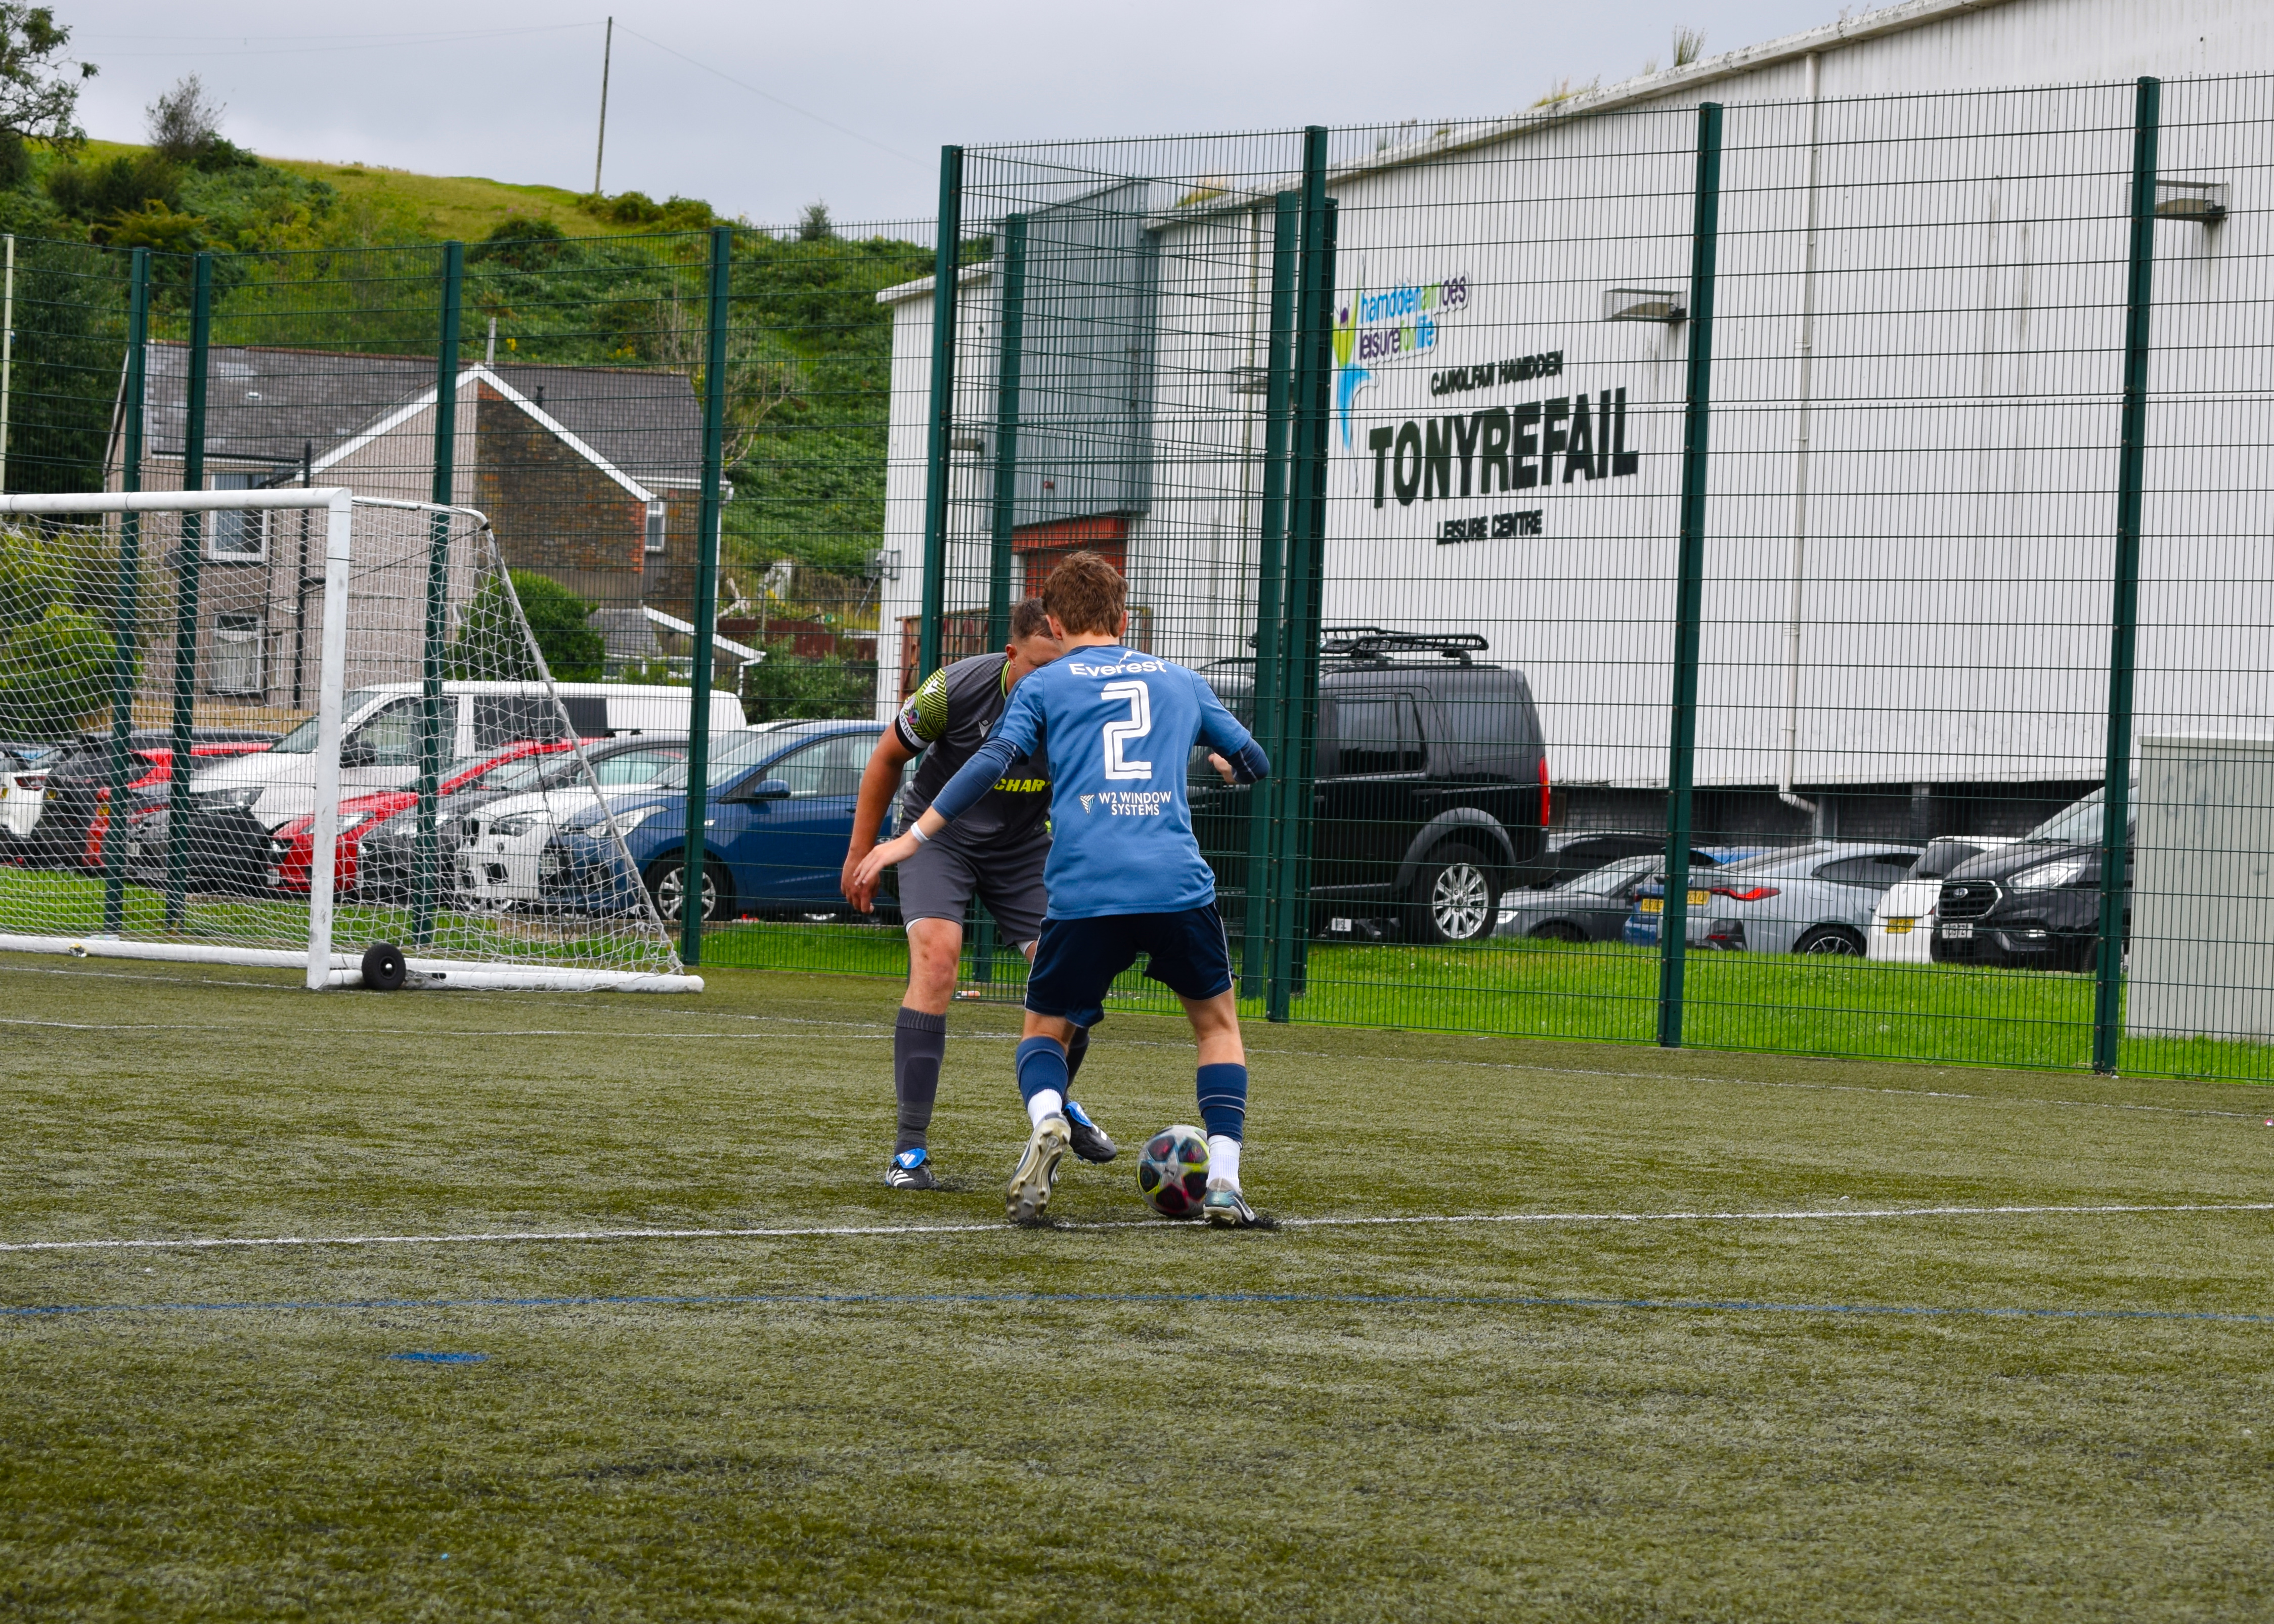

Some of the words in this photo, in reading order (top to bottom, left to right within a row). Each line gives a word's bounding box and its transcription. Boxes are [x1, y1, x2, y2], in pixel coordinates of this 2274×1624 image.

[1369, 387, 1639, 509] TONYREFAIL
[1436, 515, 1488, 545] LEISURE
[1492, 509, 1543, 538] CENTRE
[1069, 660, 1167, 677] Everest
[1101, 680, 1152, 780] 2
[993, 778, 1052, 792] CHAR
[1099, 792, 1117, 804] W2
[1120, 791, 1171, 804] WINDOW
[1111, 803, 1160, 816] SYSTEMS
